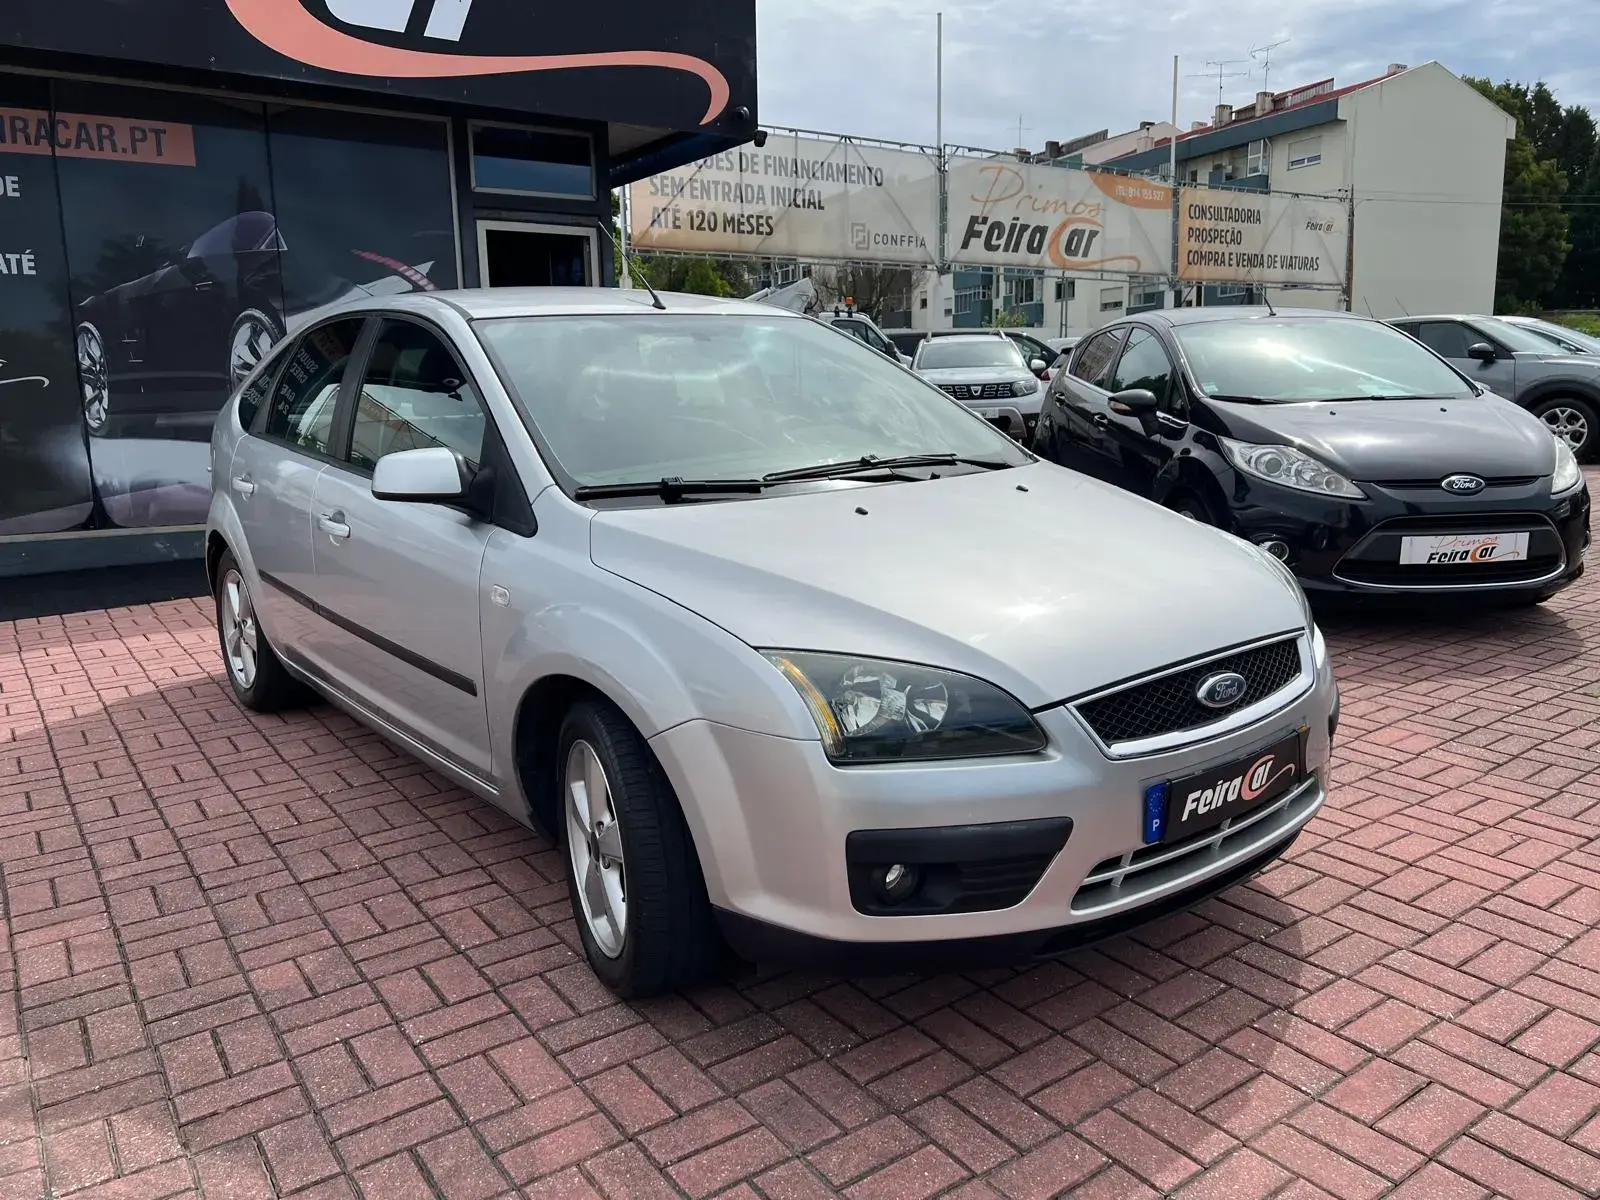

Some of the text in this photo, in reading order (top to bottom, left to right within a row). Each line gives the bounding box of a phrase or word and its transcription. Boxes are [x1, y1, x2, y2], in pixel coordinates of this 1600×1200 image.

[739, 152, 759, 175] DE
[763, 155, 884, 188] FINANCIAMENTO
[649, 174, 825, 211] SEM ENTRADA INICIAL
[970, 165, 1105, 222] Primos
[651, 203, 775, 236] ATÉ 120 MESES
[1188, 203, 1262, 225] CONSULTADORIA
[873, 232, 928, 249] CONFFIA
[1187, 226, 1243, 248] PROSPEÇÃO
[1187, 249, 1321, 272] COMPRA E VENDA DE VIATURAS
[1452, 478, 1476, 489] Ford
[1215, 680, 1238, 700] Ford
[1152, 819, 1160, 832] P
